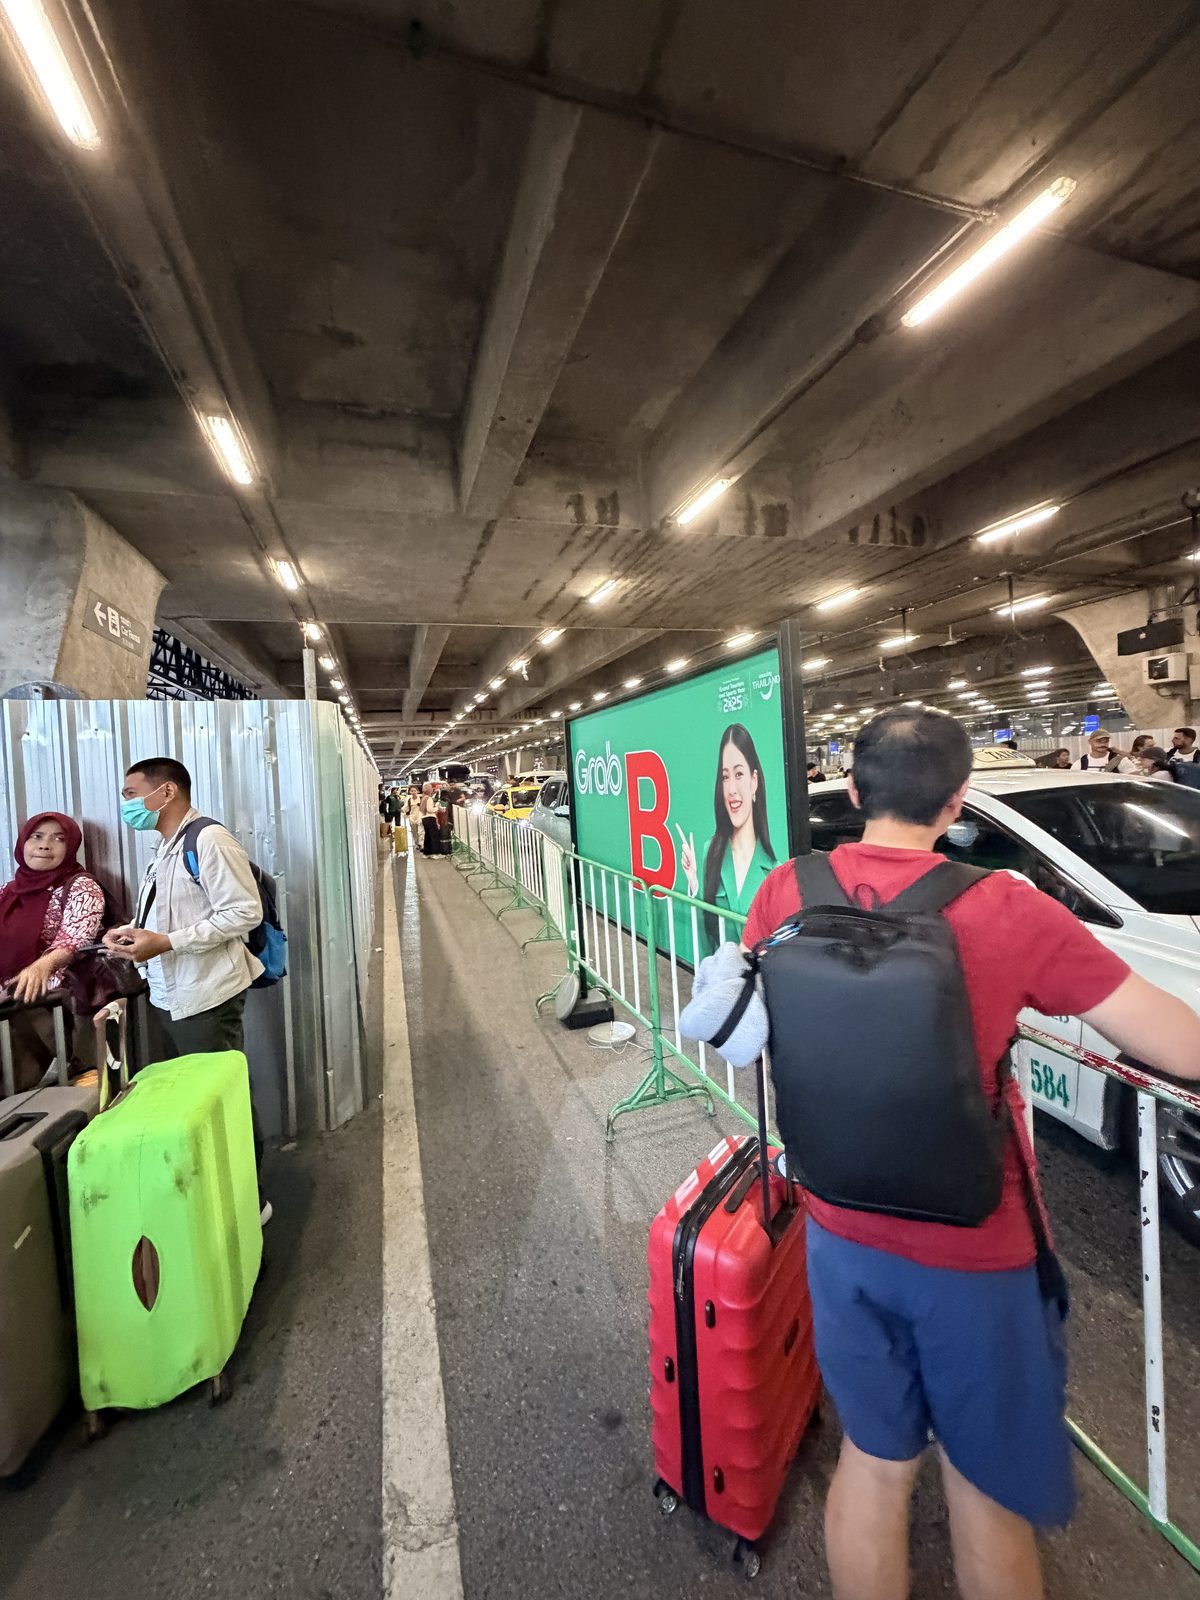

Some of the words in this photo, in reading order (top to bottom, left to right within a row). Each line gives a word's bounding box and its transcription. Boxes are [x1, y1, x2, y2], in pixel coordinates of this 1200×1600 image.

[723, 694, 743, 713] 2025
[752, 674, 781, 690] THAILAND
[575, 741, 622, 796] Grab
[625, 749, 677, 899] B
[1030, 1058, 1070, 1109] 584
